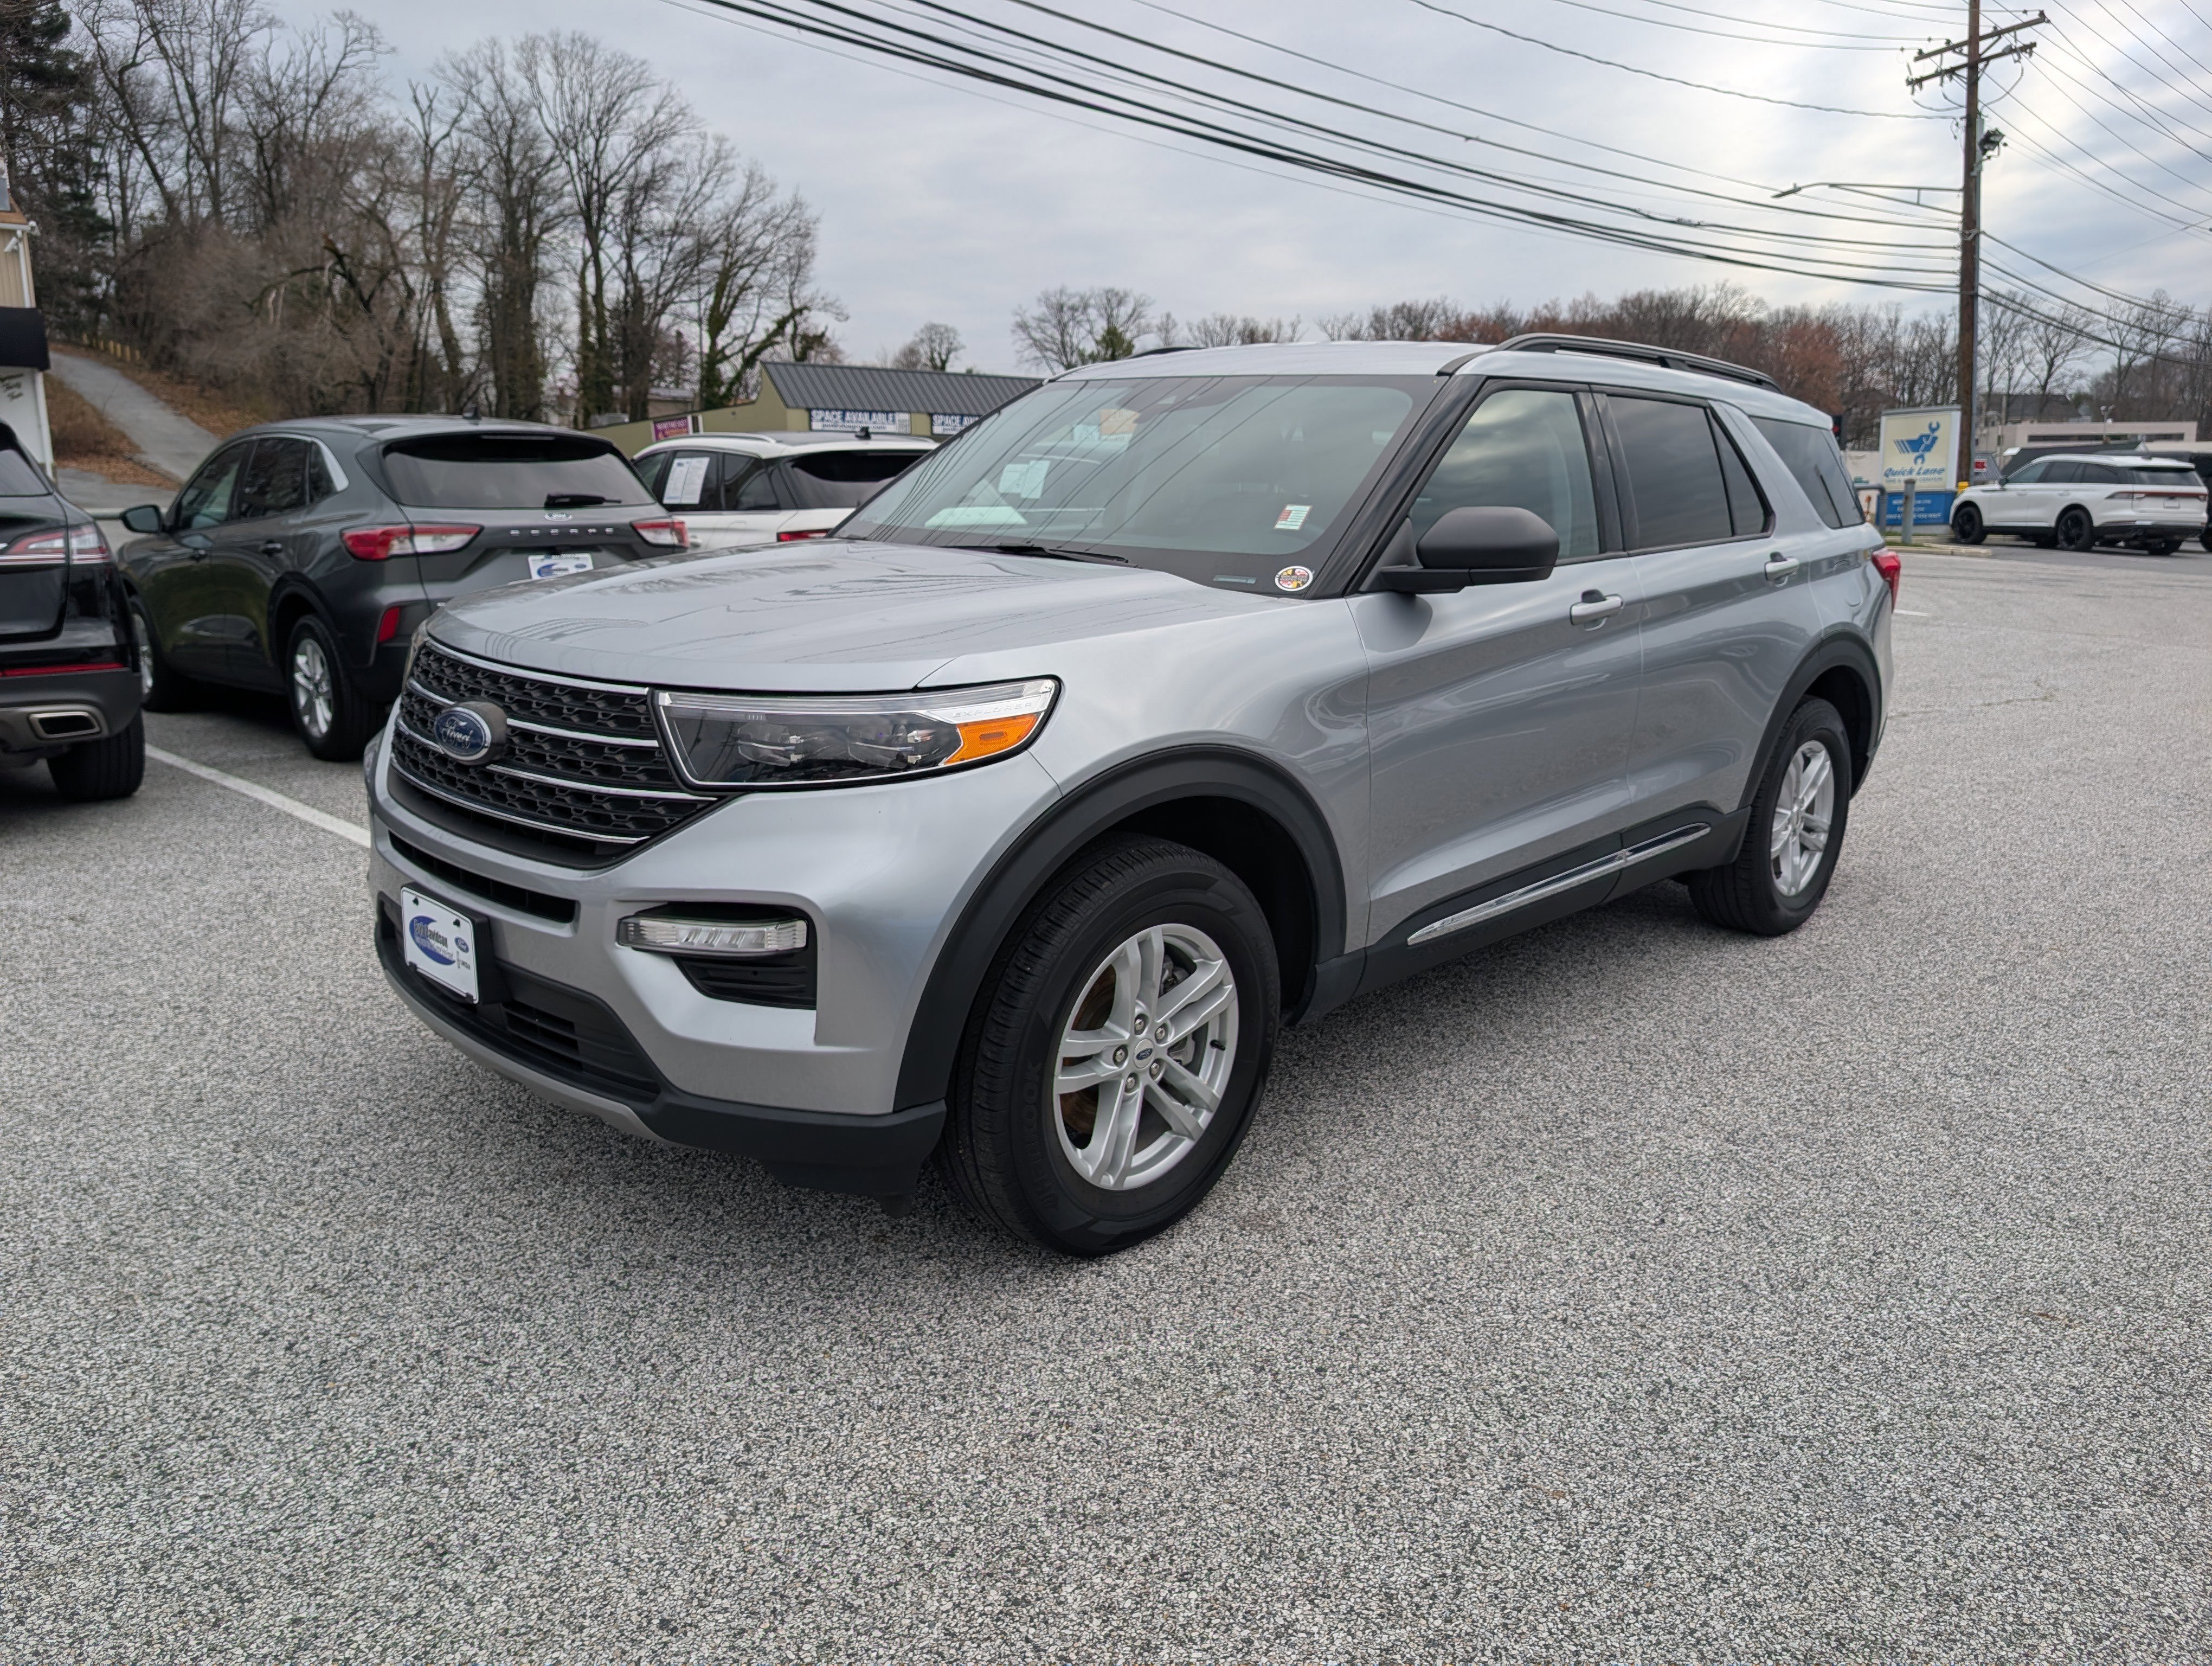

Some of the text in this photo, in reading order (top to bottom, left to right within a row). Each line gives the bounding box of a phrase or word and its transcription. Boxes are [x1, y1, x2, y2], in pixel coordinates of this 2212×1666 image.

[811, 409, 895, 425] SPACE AVAILABLE
[933, 414, 961, 426] SPACE
[1883, 466, 1945, 478] Quick Lane
[510, 528, 614, 536] ESCAPE
[953, 702, 1032, 717] EXPLORER
